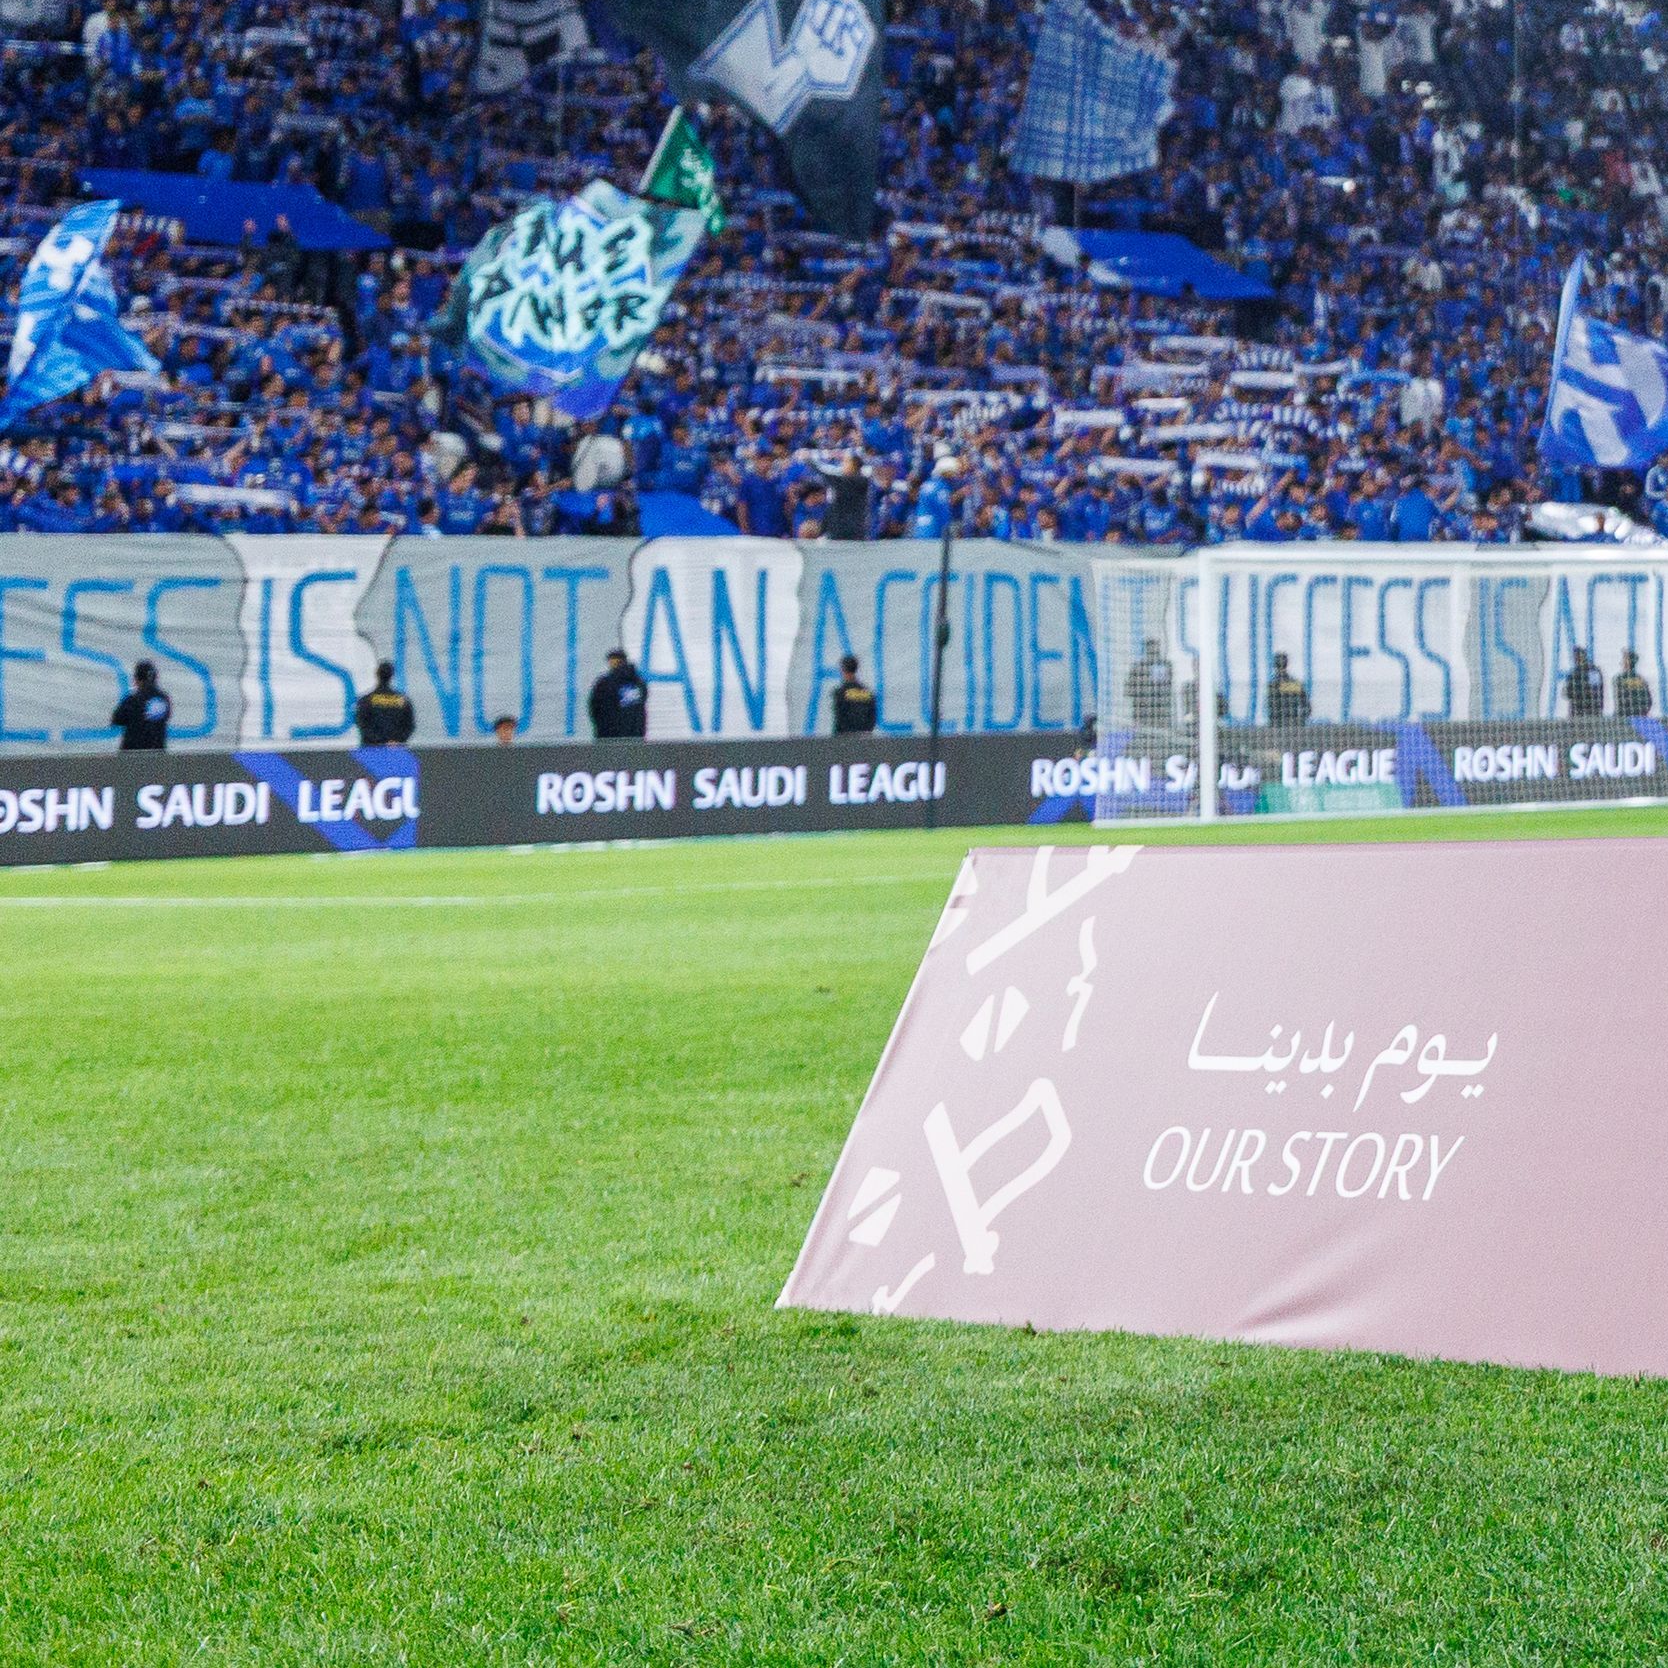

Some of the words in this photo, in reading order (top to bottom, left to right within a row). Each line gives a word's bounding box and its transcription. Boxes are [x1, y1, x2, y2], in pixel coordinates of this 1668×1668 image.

[0, 575, 221, 741] ESS
[259, 568, 359, 740] IS
[394, 563, 609, 739] NOT
[638, 566, 769, 733] AN
[1479, 575, 1529, 721] IS
[536, 769, 677, 816] ROSHN
[692, 765, 807, 812] SAUDI
[1030, 755, 1155, 799] ROSHN
[1281, 747, 1397, 789] LEAGUE
[1453, 743, 1559, 783] ROSHN
[1569, 738, 1656, 778] SAUDI
[0, 786, 113, 834] OSHN
[136, 781, 269, 830] SAUDI
[1187, 990, 1355, 1100] بدينا
[1352, 1023, 1499, 1113] يوم
[1142, 1125, 1267, 1195] OUR
[1266, 1130, 1466, 1202] STORY
